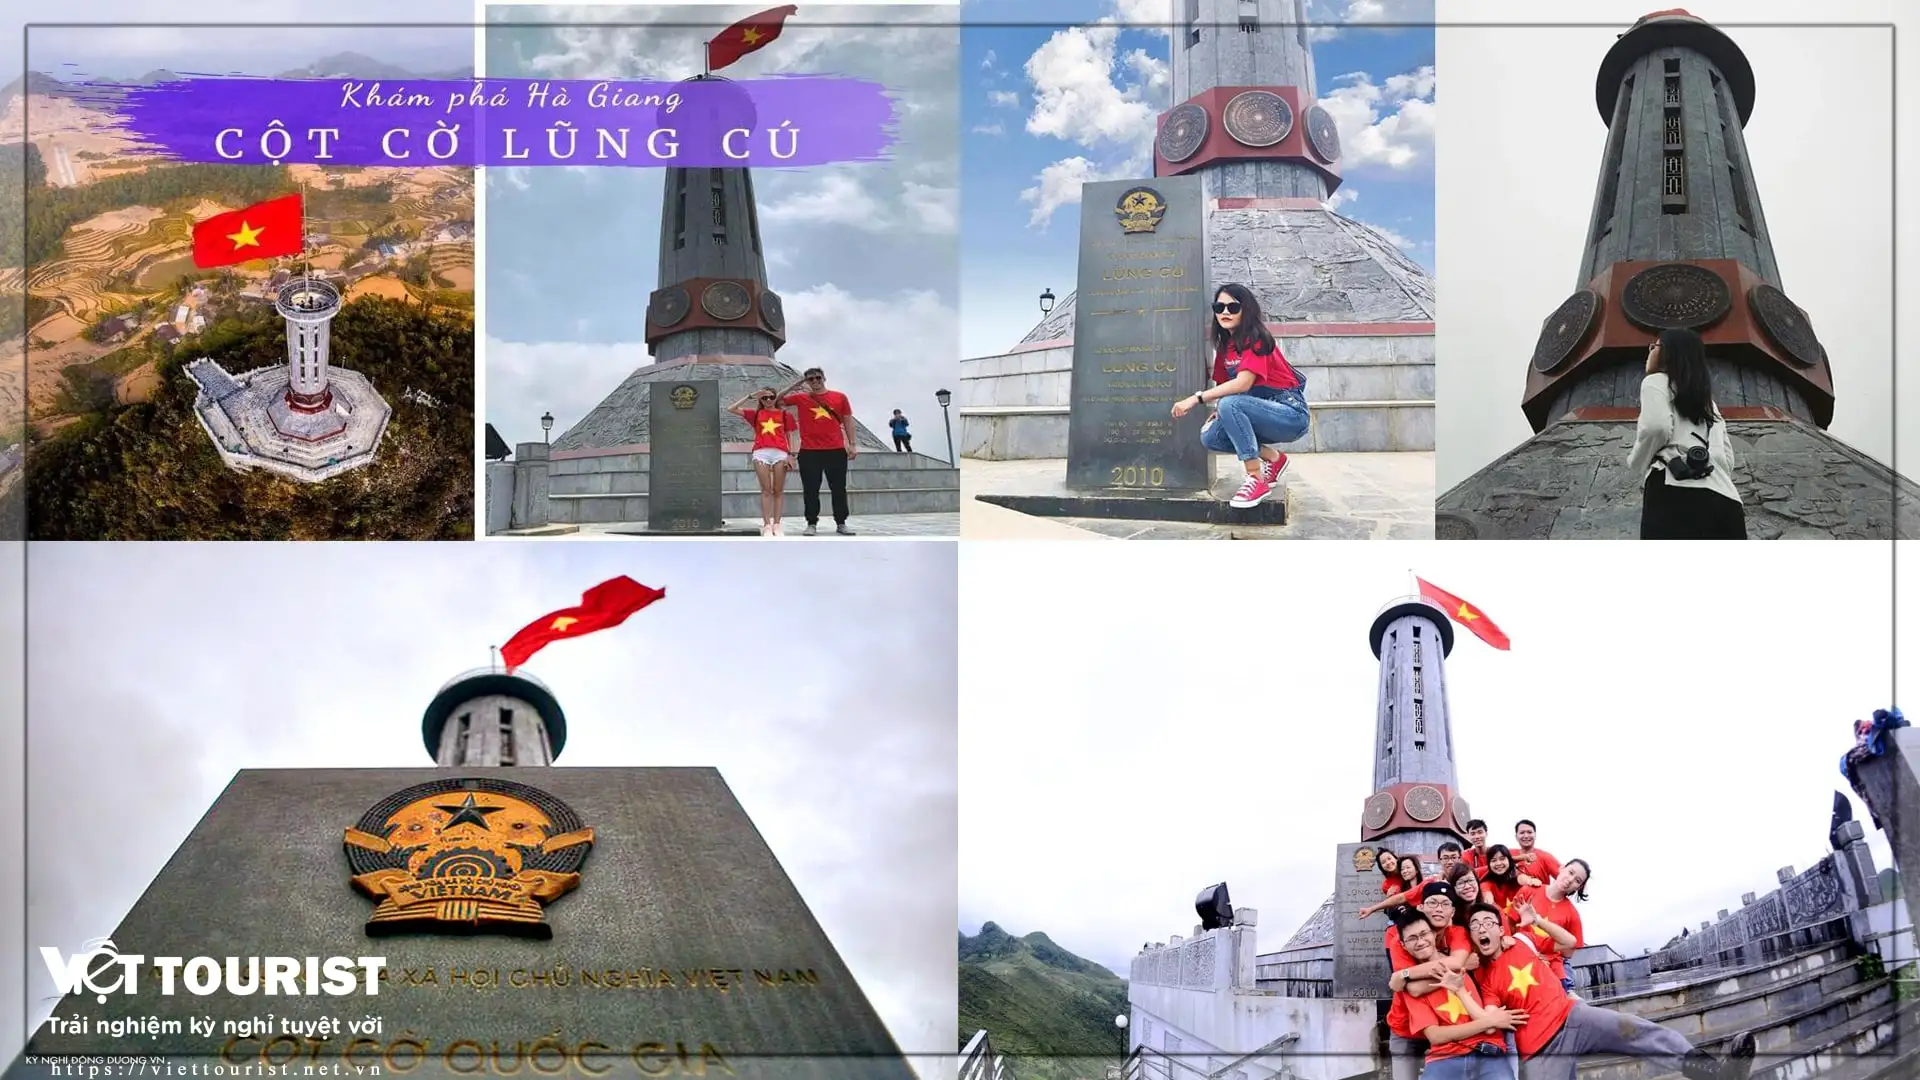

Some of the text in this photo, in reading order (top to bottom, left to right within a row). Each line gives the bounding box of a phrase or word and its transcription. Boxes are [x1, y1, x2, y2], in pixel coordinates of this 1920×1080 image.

[1110, 466, 1165, 486] 2010
[401, 964, 438, 988] XÃ
[449, 964, 499, 992] HỘI
[509, 960, 570, 989] CHỦ
[580, 965, 677, 989] NGHĨA
[753, 968, 820, 988] NAM
[342, 1028, 431, 1075] CỜ
[443, 1028, 613, 1077] QUỐC
[632, 1041, 736, 1078] GIA
